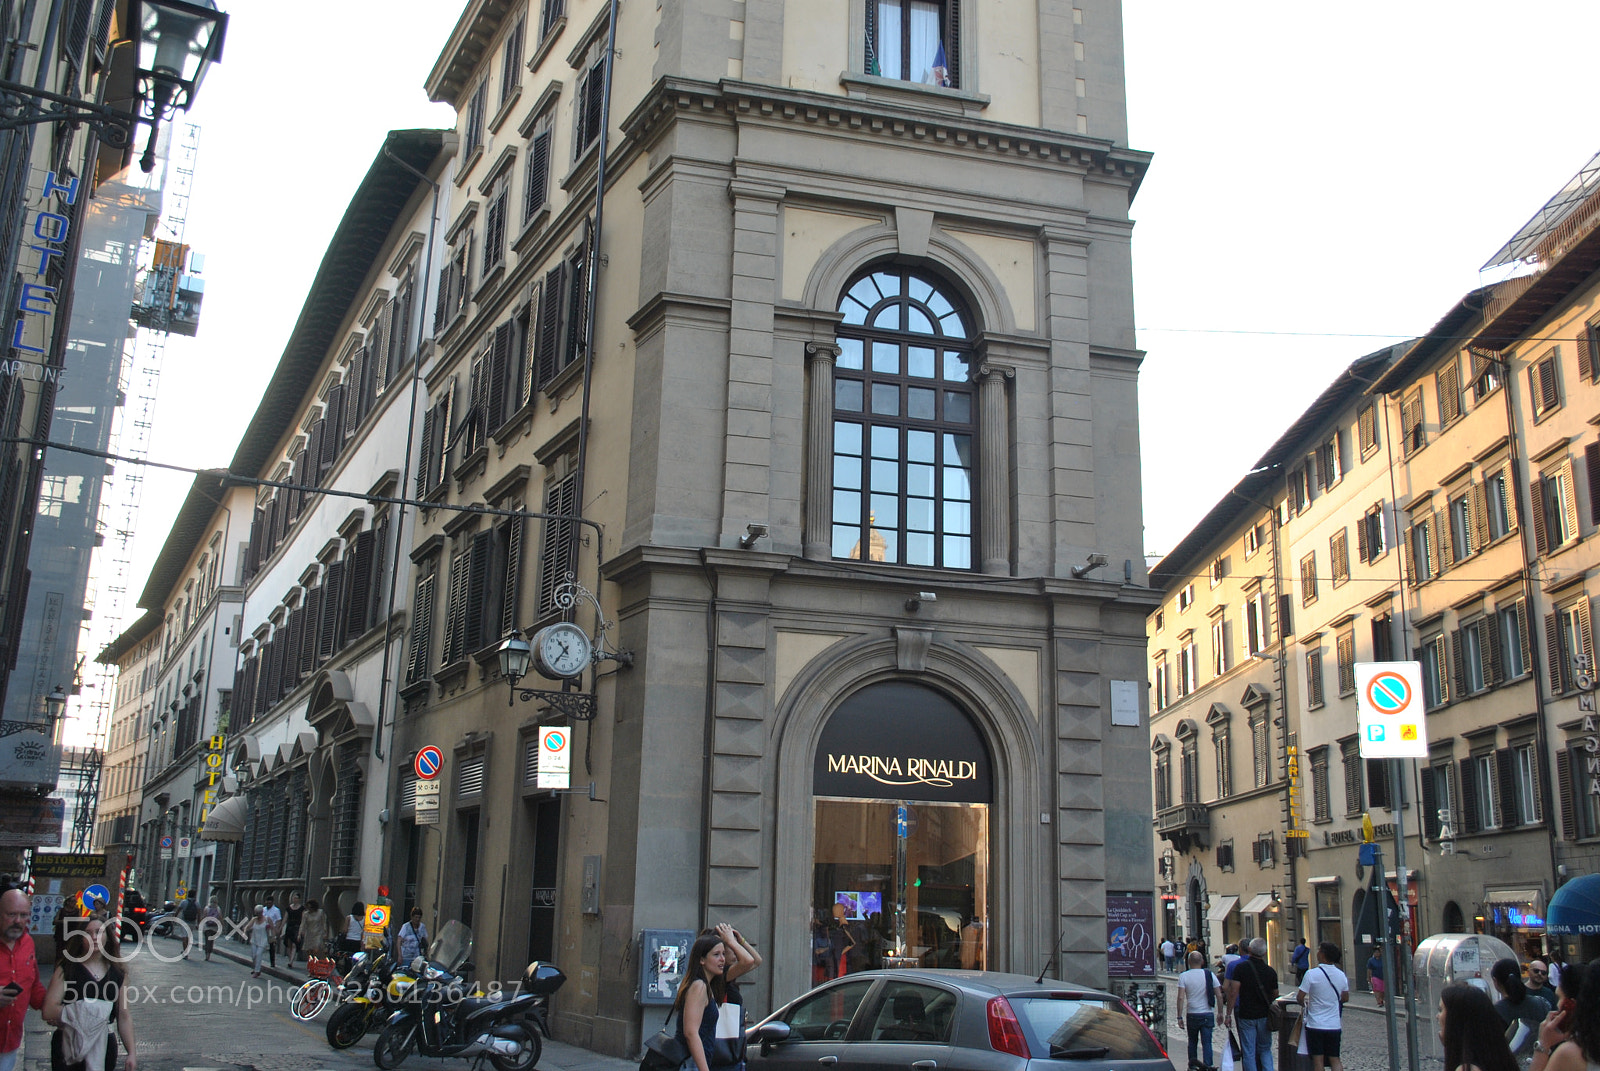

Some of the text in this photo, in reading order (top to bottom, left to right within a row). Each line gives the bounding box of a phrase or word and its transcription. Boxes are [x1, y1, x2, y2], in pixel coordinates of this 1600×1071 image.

[13, 171, 79, 353] HOTEL
[1370, 725, 1383, 740] P
[828, 754, 977, 785] MARINA RINALDI
[1287, 746, 1300, 827] MARTELLI
[34, 855, 105, 865] RISTORANTE
[48, 866, 68, 874] Alla
